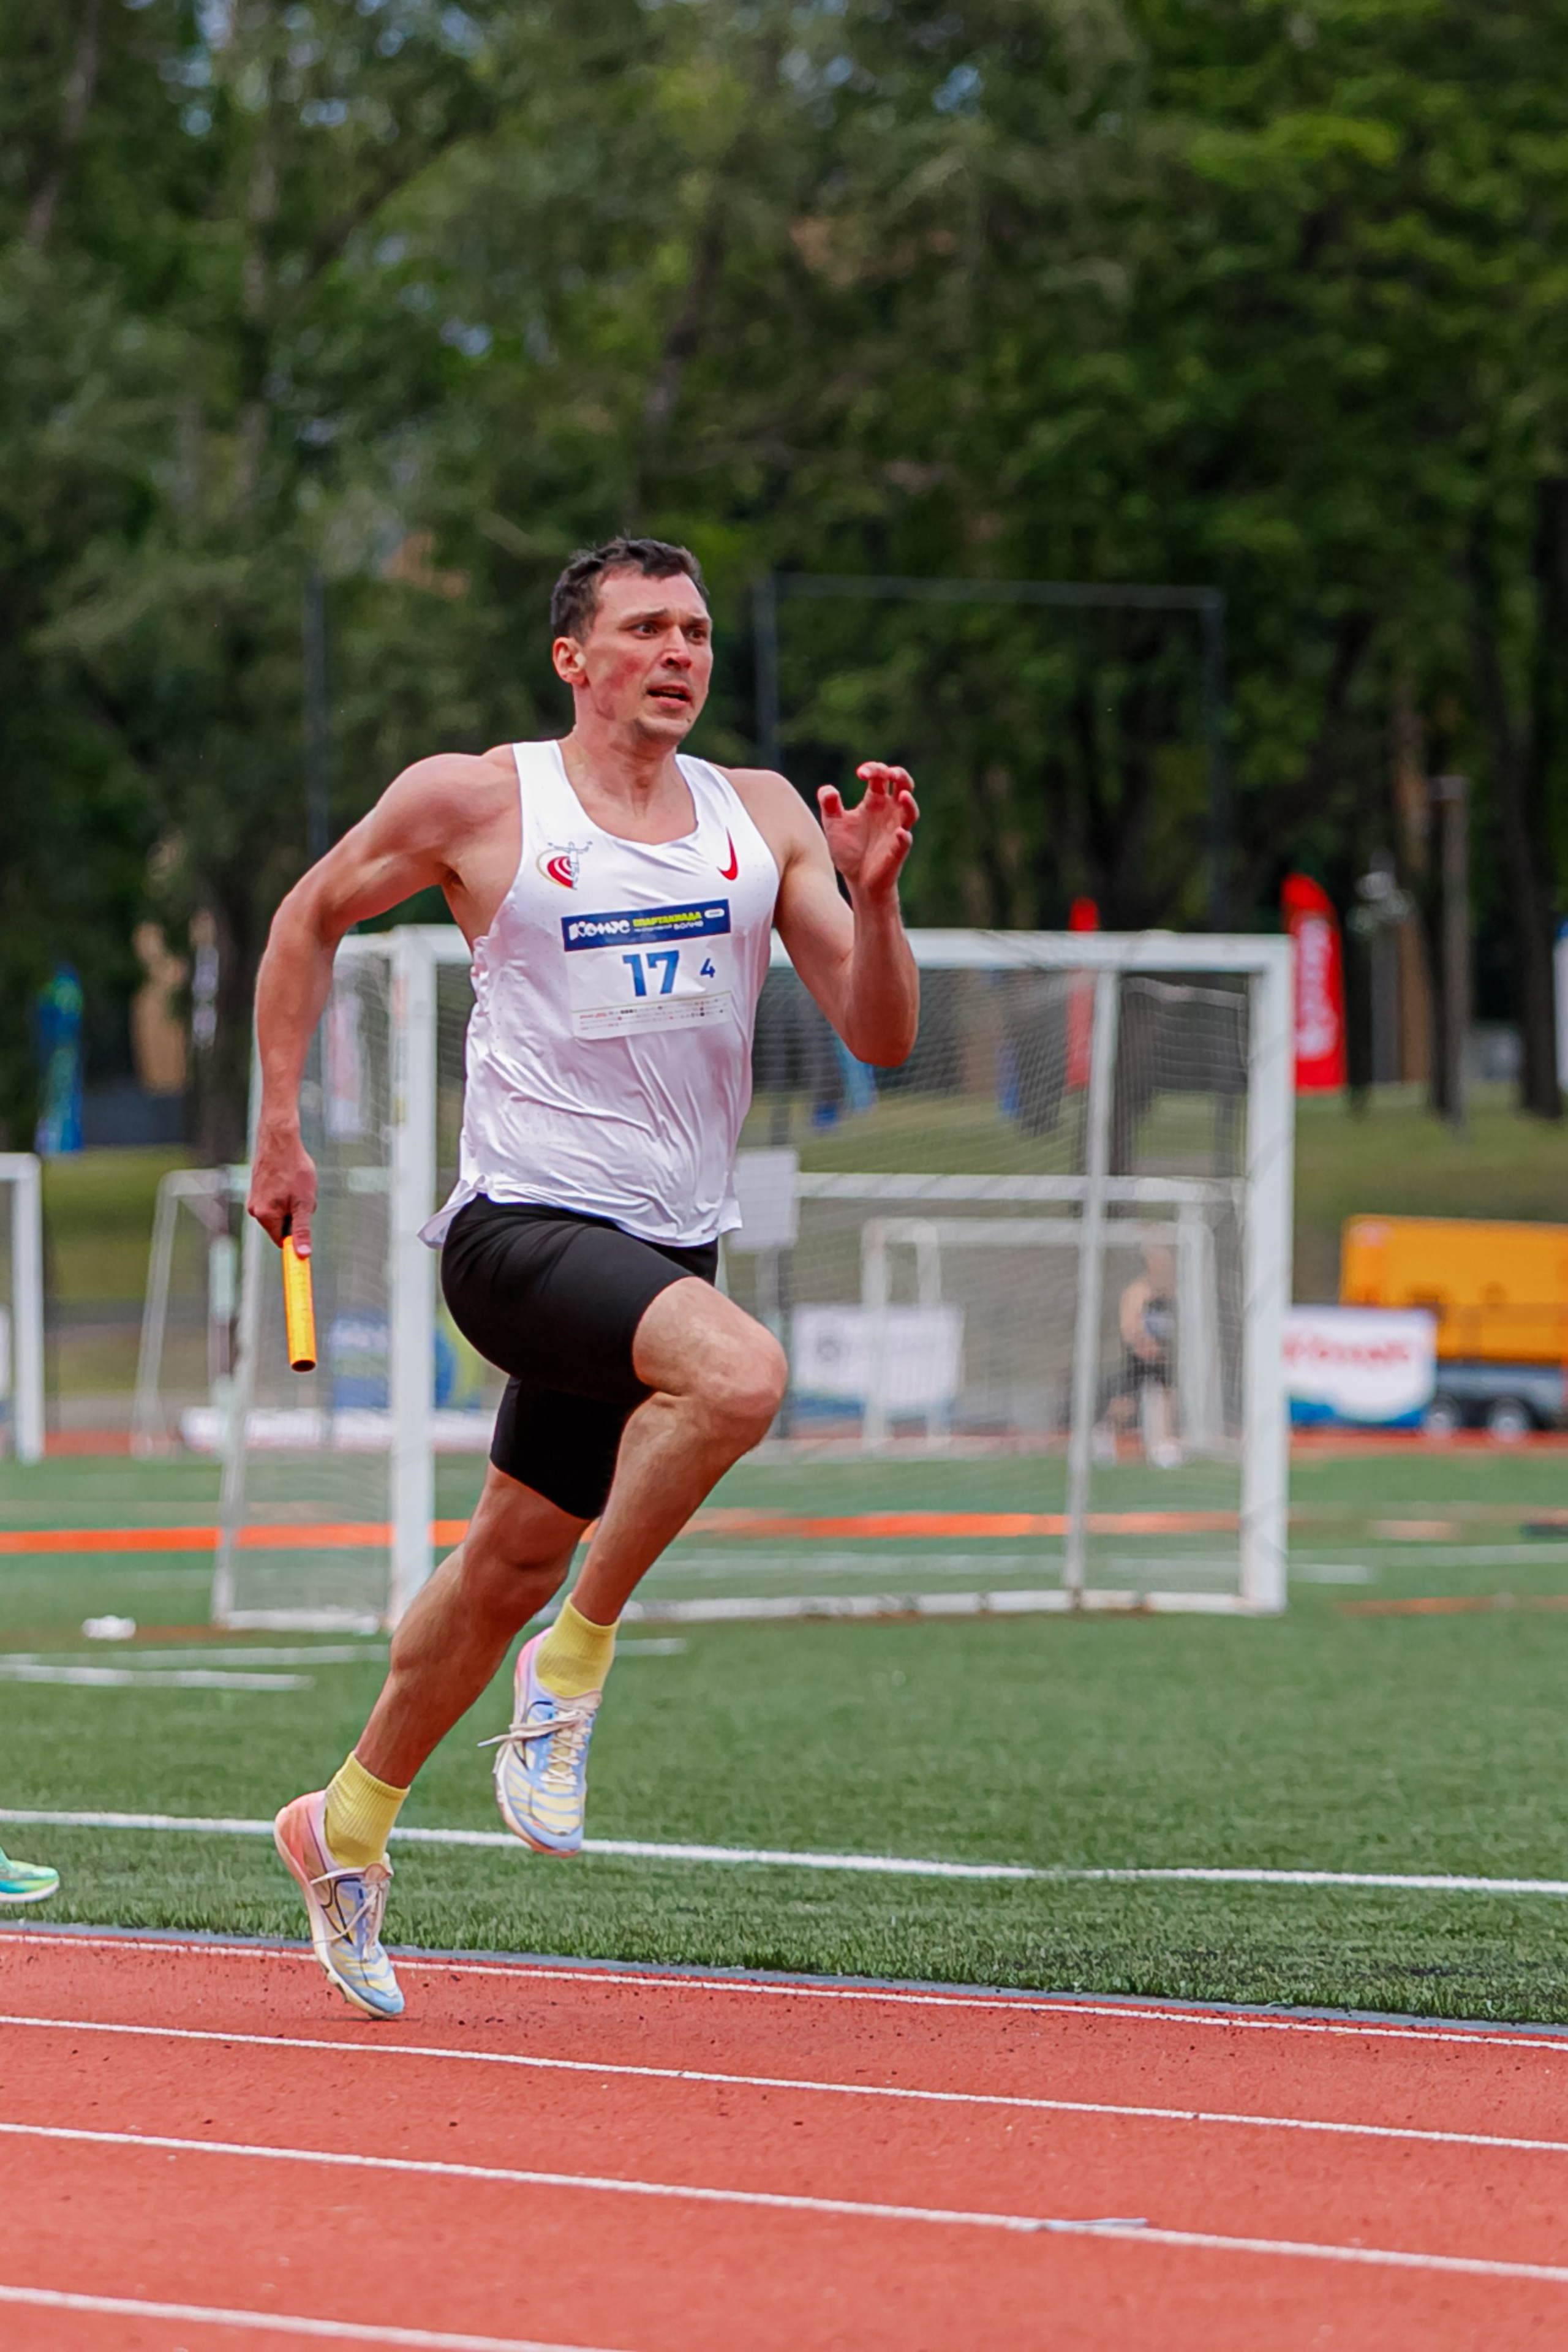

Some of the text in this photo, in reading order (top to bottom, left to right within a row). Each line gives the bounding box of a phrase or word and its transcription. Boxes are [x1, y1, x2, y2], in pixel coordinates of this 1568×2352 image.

[632, 911, 702, 927] СПАРТАКИАДА
[622, 950, 679, 997] 17
[700, 958, 715, 978] 4
